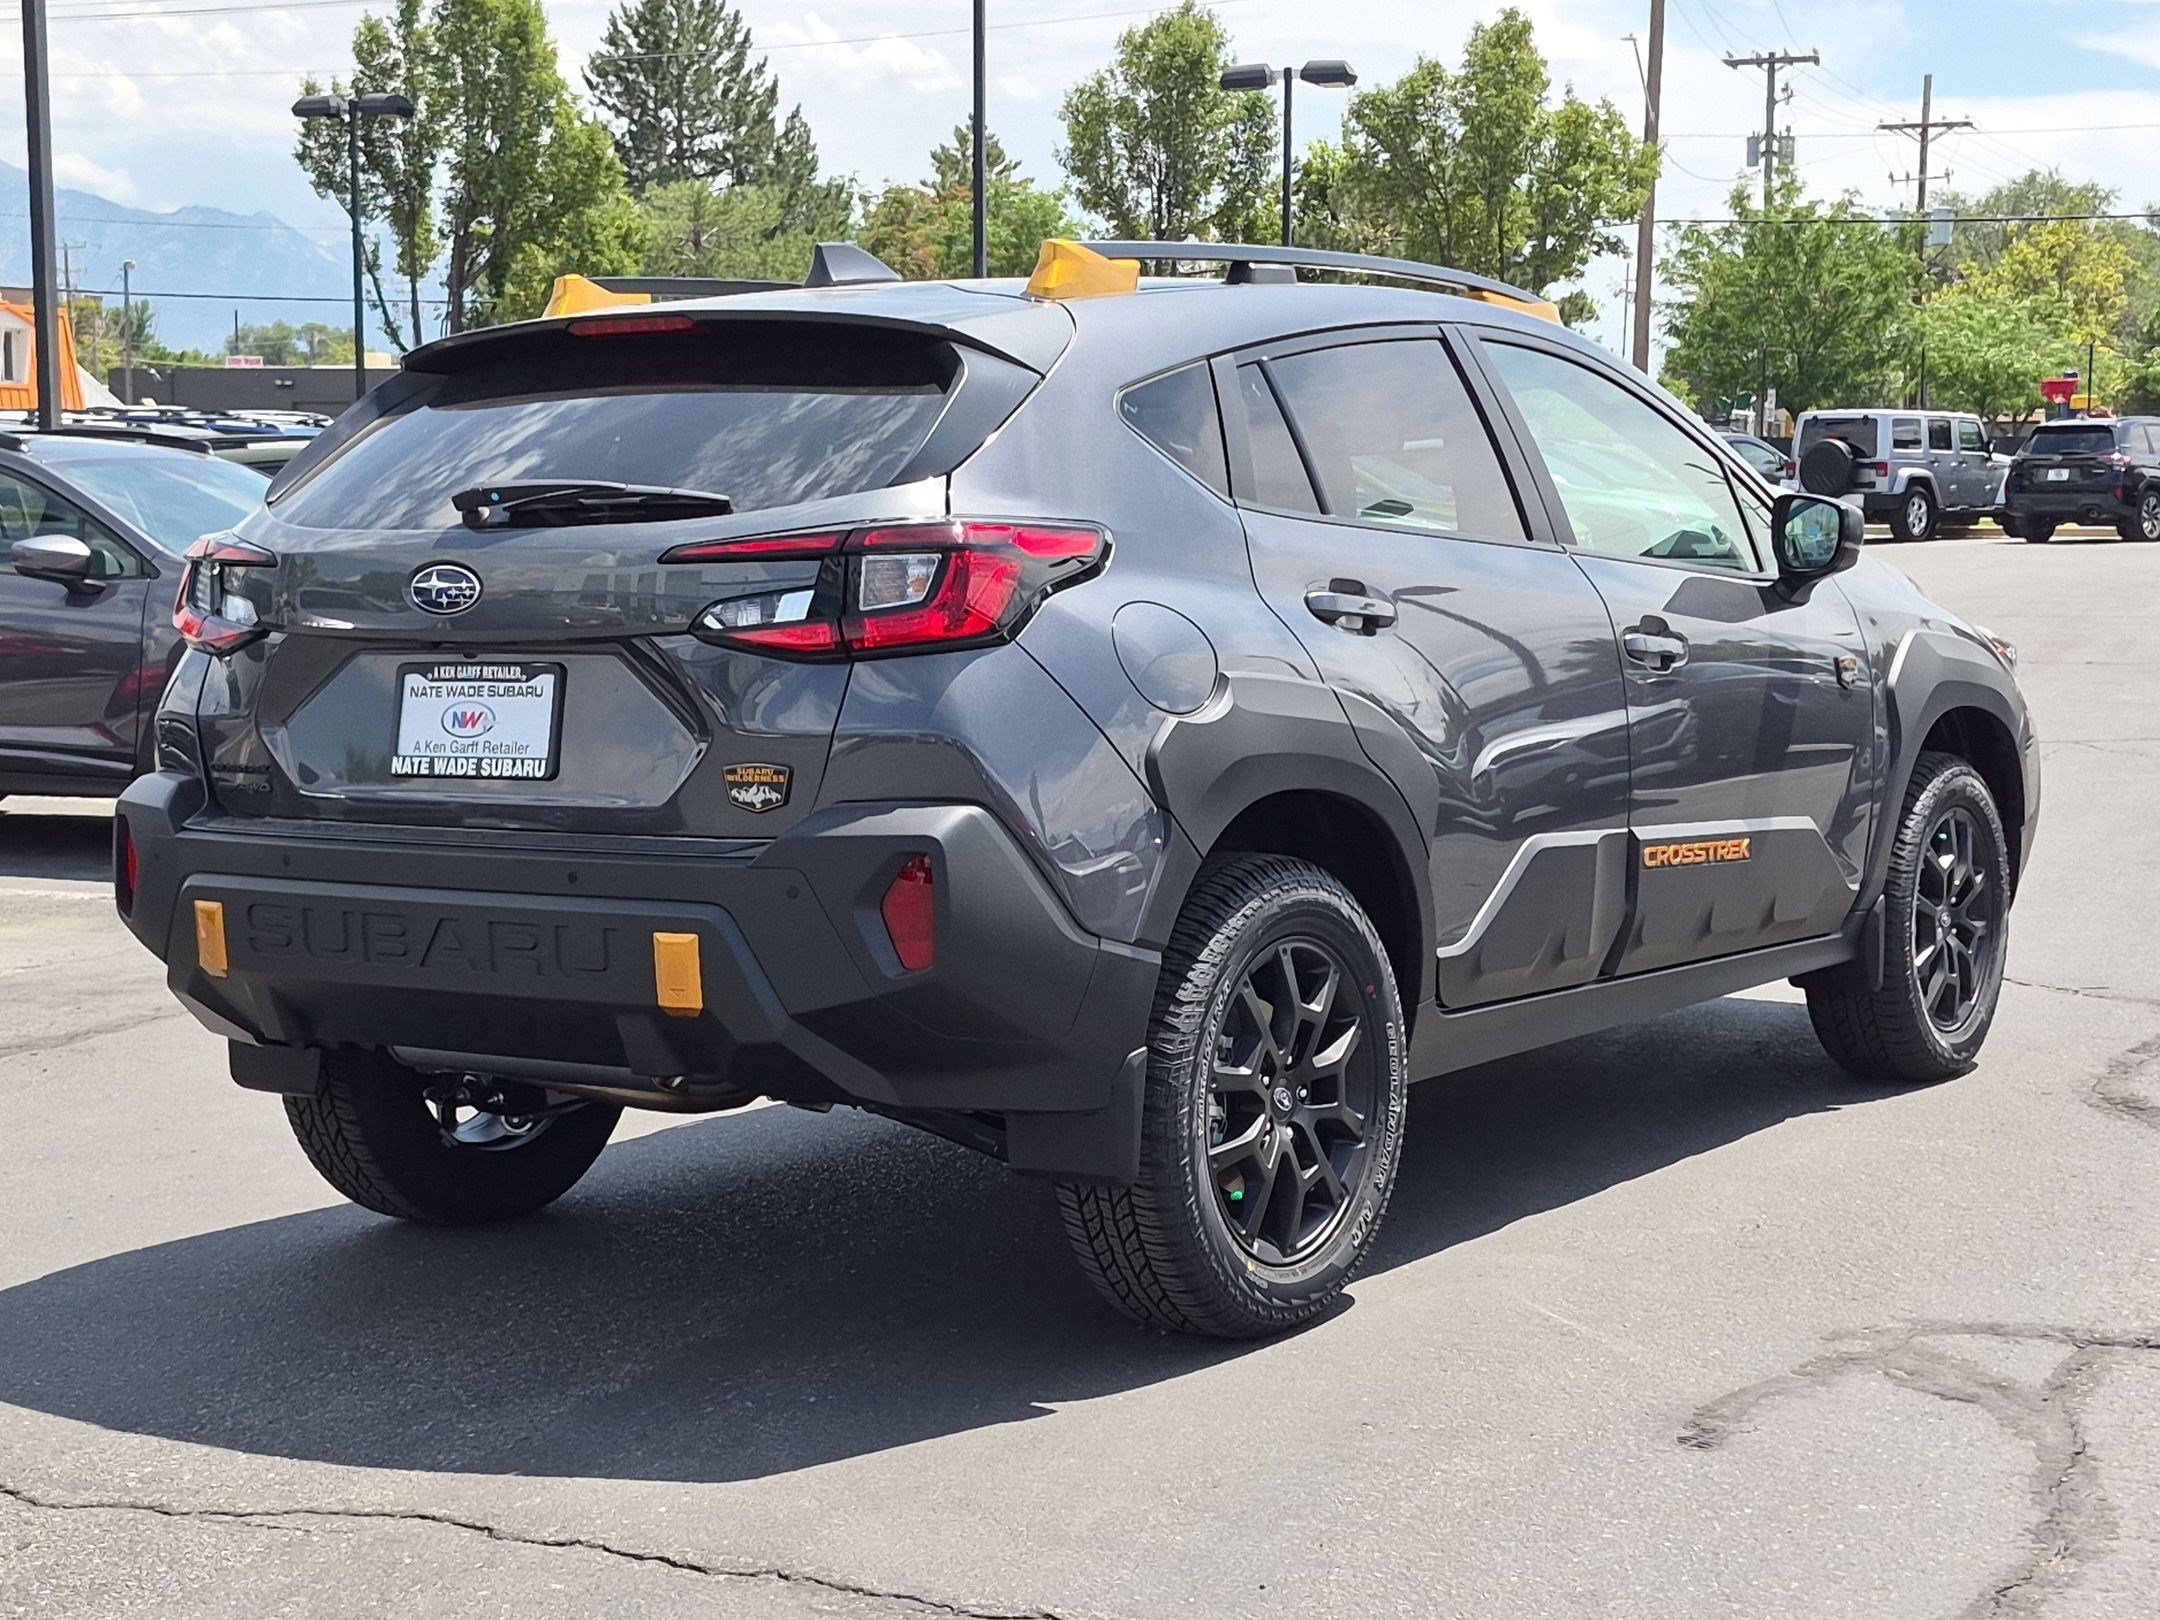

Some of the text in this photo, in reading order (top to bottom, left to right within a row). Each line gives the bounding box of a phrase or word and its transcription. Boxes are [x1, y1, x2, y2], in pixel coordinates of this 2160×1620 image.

[434, 667, 522, 680] A KEN GARFF RETAILER
[410, 685, 544, 698] NATE WADE SUBARU
[452, 711, 484, 729] NW
[413, 741, 530, 755] A Ken Garff Retailer
[391, 756, 547, 778] NATE WADE SUBARU
[1643, 838, 1751, 867] CROSSTREK
[246, 903, 621, 978] SUBARU
